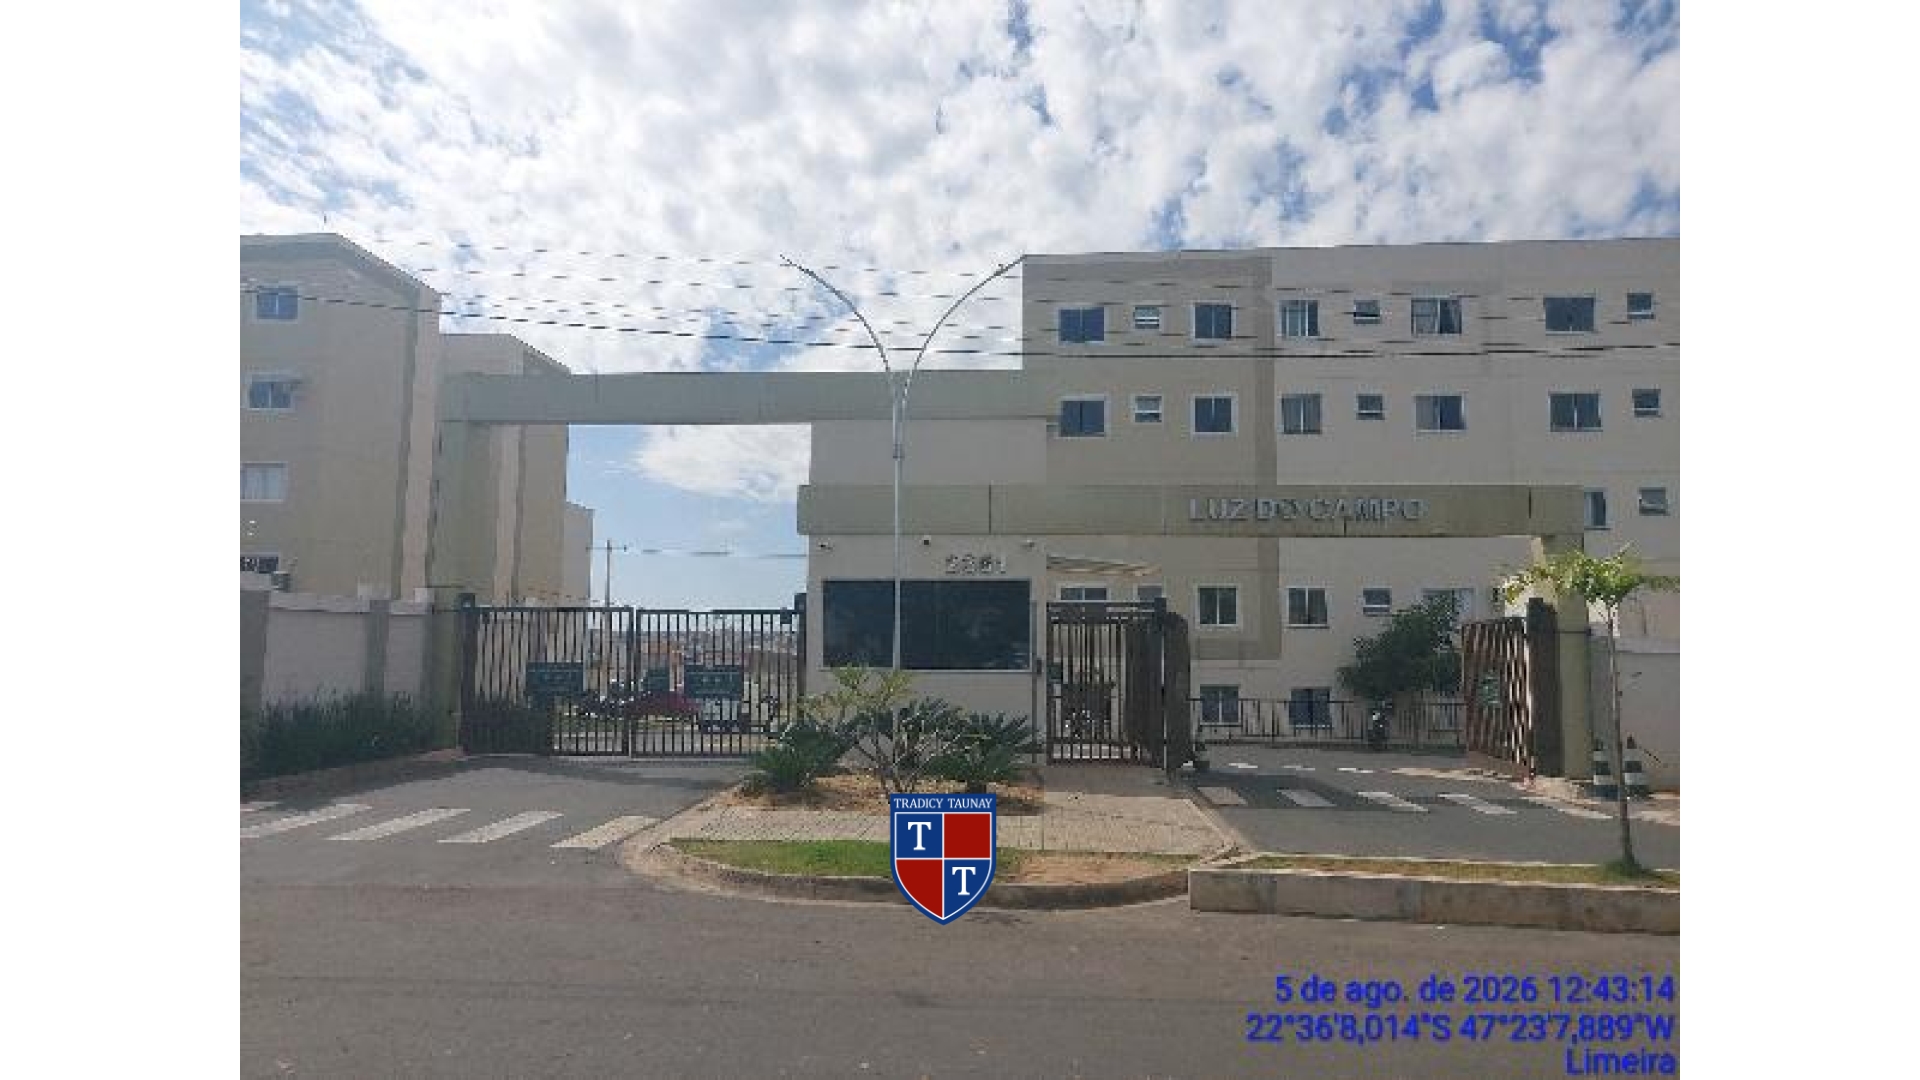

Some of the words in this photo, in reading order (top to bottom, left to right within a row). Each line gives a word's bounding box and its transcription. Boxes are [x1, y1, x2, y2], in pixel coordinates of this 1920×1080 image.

[1189, 499, 1247, 521] LUZ
[1254, 499, 1301, 521] DO
[1307, 499, 1426, 521] CAMPO
